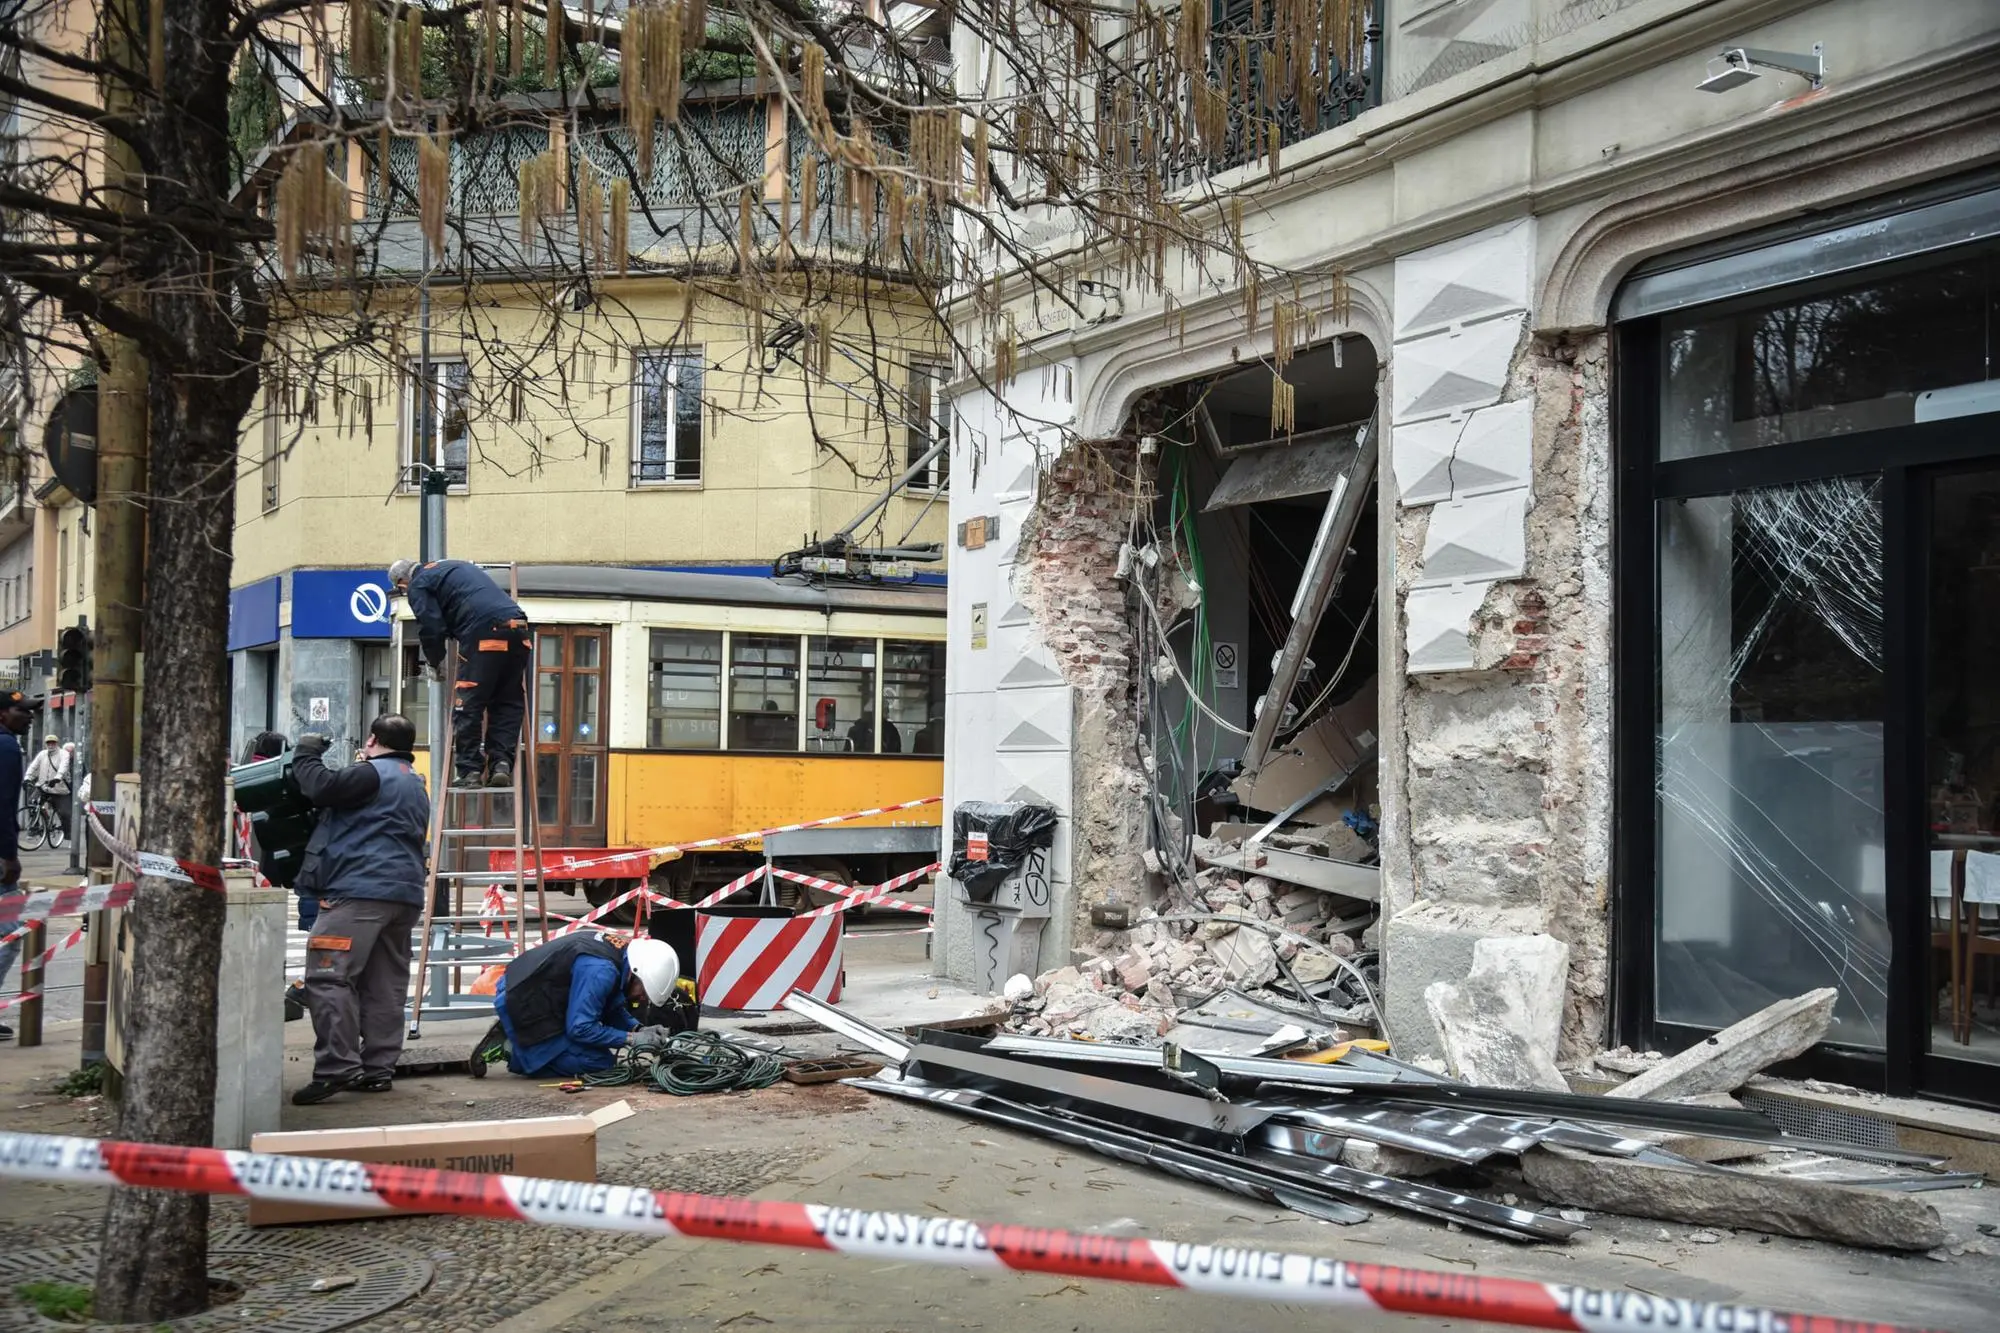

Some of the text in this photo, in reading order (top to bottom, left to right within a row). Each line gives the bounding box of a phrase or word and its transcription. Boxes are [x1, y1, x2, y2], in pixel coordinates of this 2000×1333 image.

[445, 1153, 515, 1173] HANDLE
[519, 1177, 605, 1213] FUOCO
[1173, 1242, 1283, 1281] FUOCO
[1308, 1256, 1362, 1289] DEL
